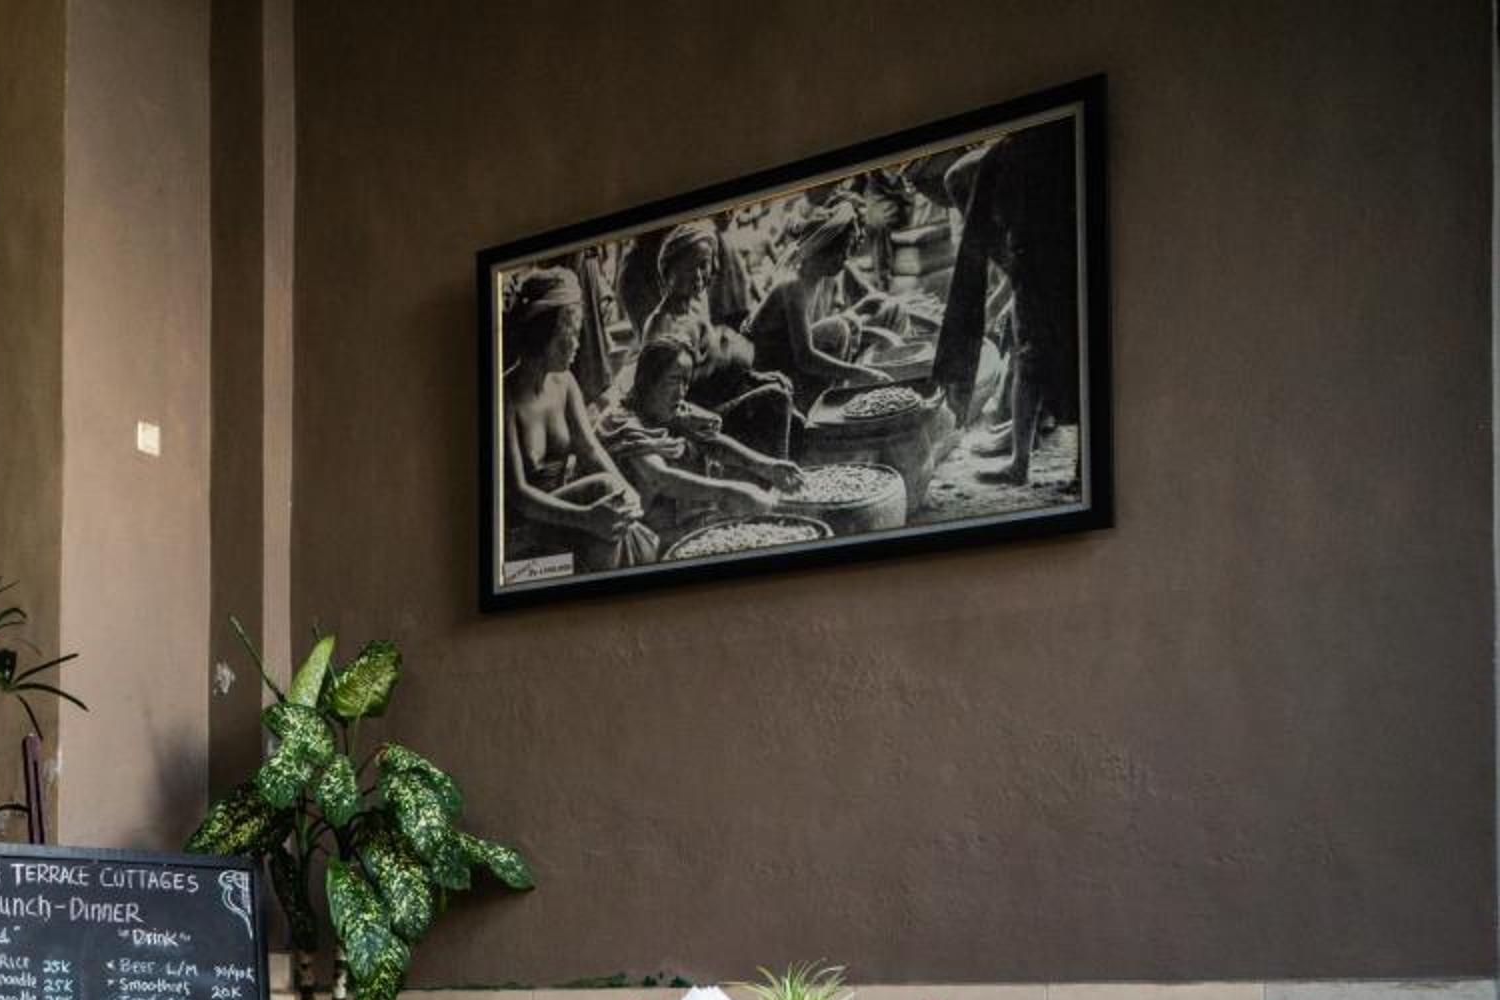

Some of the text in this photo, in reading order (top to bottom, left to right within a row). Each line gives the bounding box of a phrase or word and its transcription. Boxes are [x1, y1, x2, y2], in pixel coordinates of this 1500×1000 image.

[11, 862, 91, 887] TERRACE
[99, 866, 199, 893] COTTAGES
[42, 960, 72, 973] 25K
[43, 979, 73, 993] 25K
[211, 985, 243, 999] 20K
